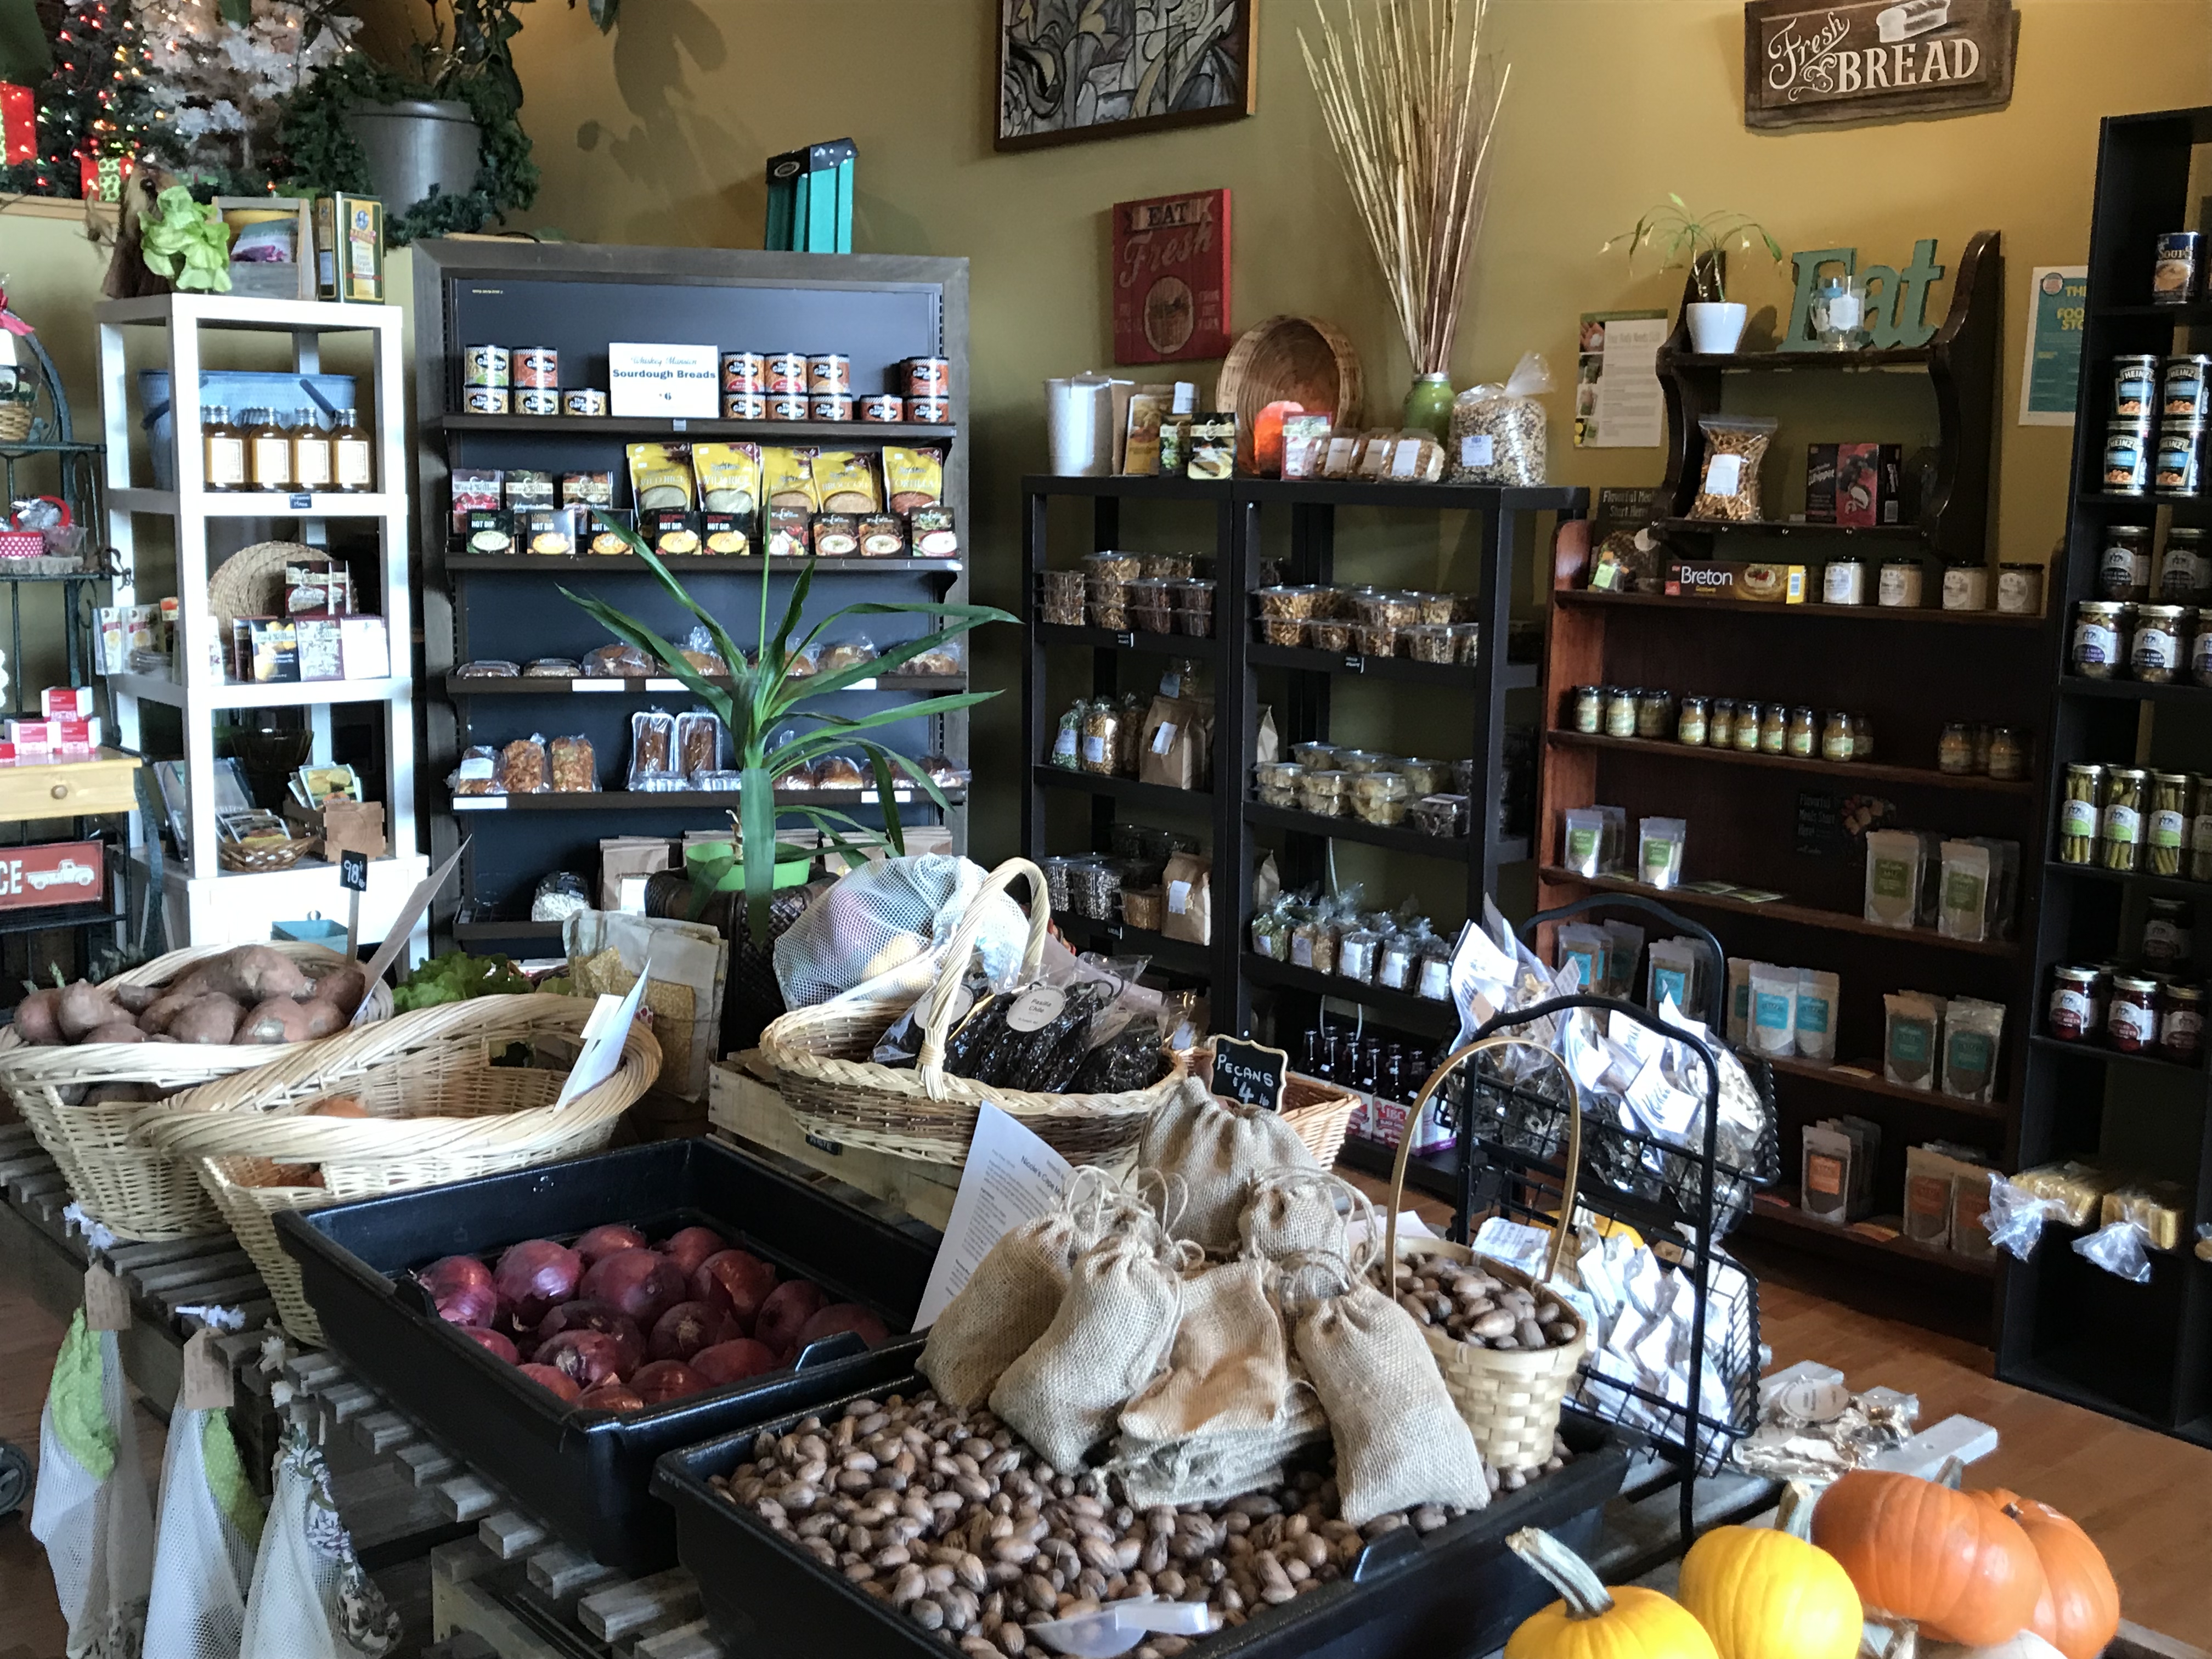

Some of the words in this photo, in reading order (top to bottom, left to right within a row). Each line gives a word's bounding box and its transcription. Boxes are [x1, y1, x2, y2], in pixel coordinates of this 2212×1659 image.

[1768, 12, 1849, 90] Fresh
[1835, 38, 1979, 93] BREAD
[1147, 202, 1187, 225] EAT
[1120, 212, 1212, 287] Fresh
[1776, 239, 1945, 352] Eat
[2057, 308, 2085, 320] FOO
[613, 369, 674, 380] Sourdough
[677, 370, 716, 379] Breads
[2125, 370, 2149, 379] HEINZ
[2171, 369, 2194, 377] HEINZ
[2111, 439, 2133, 448] HEINZ
[1681, 566, 1733, 585] Breton
[1217, 1054, 1274, 1087] PECANS
[1386, 1107, 1404, 1120] IBC
[1021, 1155, 1041, 1177] Nicole's
